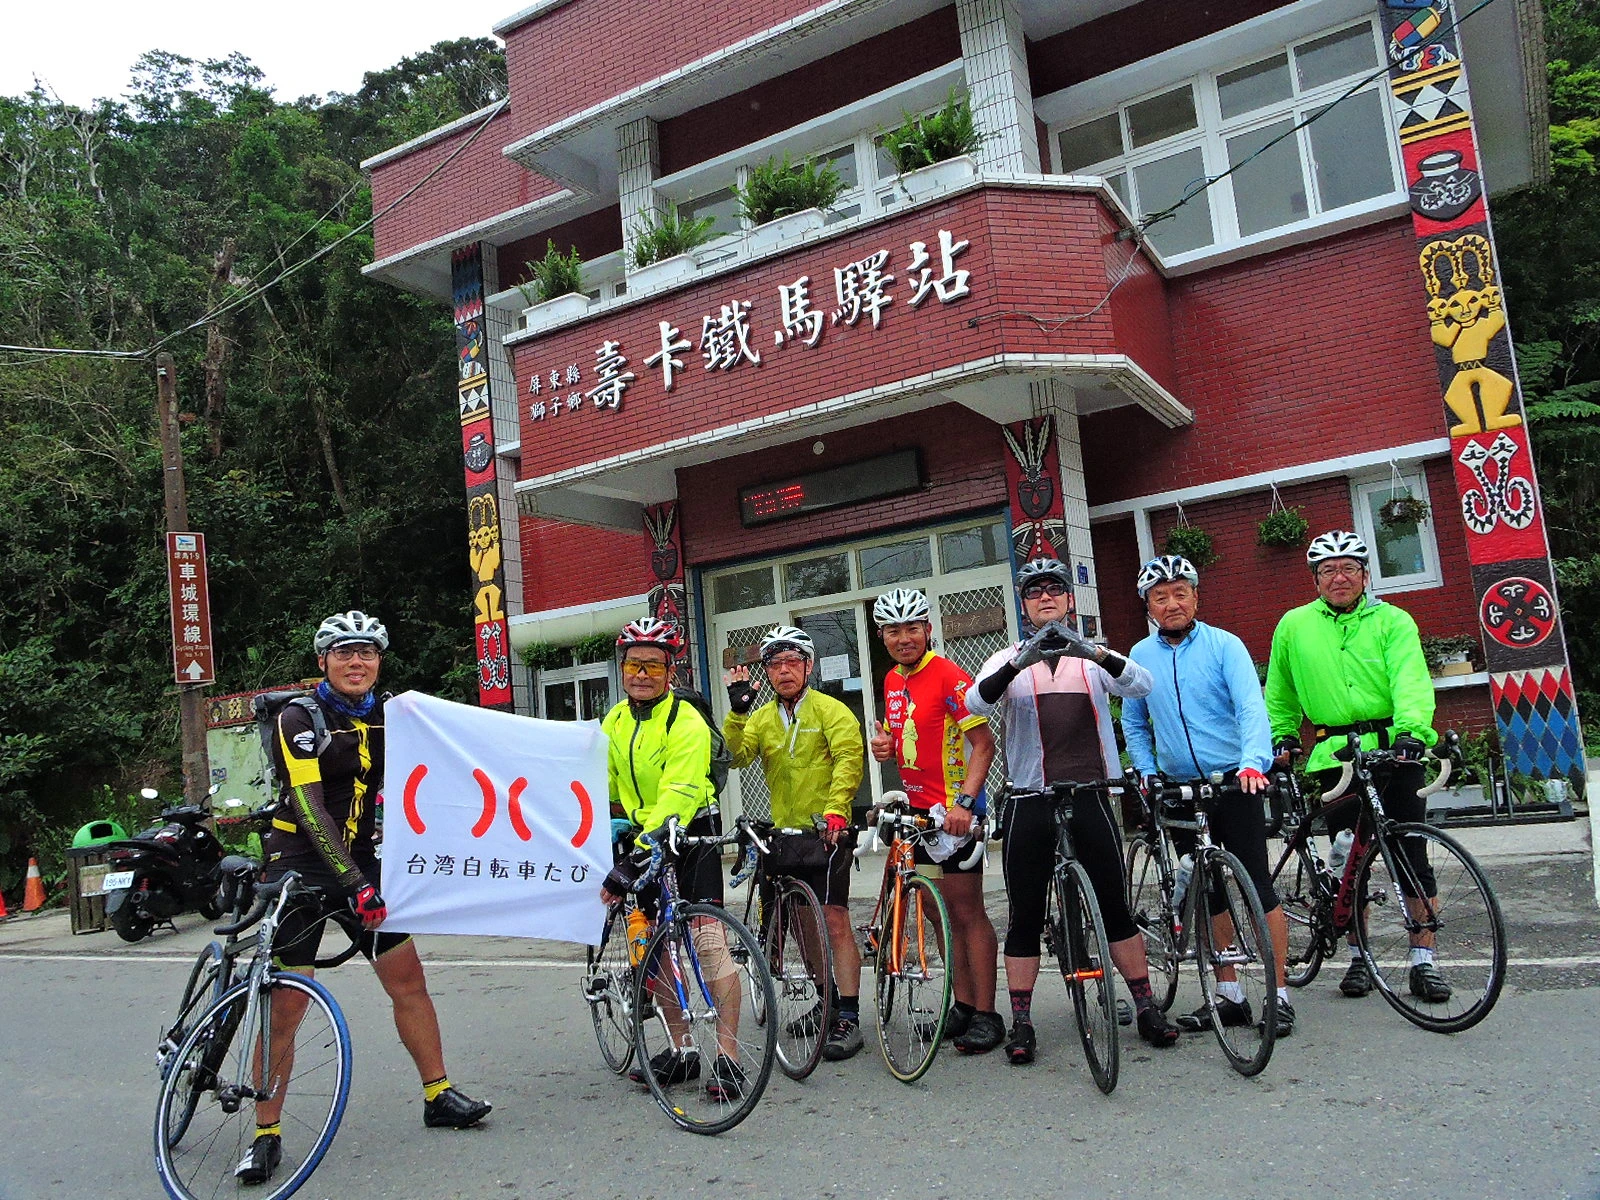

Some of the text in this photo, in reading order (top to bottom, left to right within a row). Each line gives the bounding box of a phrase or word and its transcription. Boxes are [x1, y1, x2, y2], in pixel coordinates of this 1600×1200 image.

[585, 229, 971, 411] 壽卡鐵馬驛站
[529, 363, 580, 395] 屏東縣
[530, 391, 582, 421] 獅子鄉
[179, 562, 203, 643] 車城環線
[406, 853, 590, 883] 台湾自転車たび
